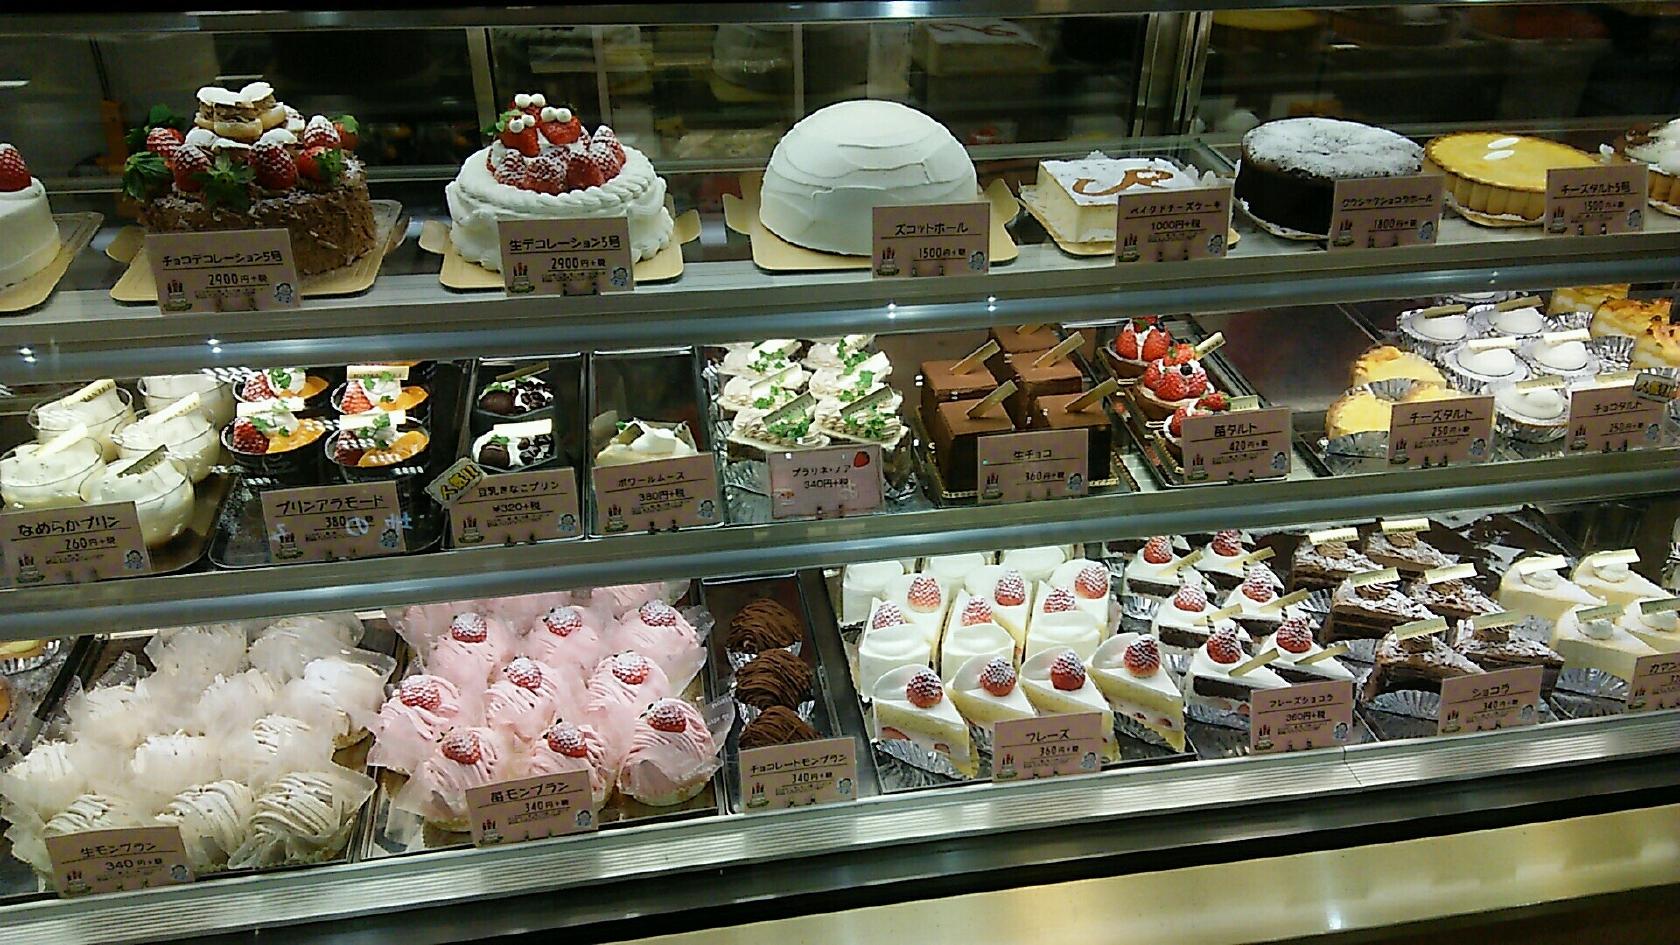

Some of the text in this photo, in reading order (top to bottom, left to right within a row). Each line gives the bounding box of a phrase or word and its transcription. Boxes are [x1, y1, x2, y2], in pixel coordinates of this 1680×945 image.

[1410, 409, 1473, 422] チーズタルト
[1014, 449, 1052, 461] 生チョコ
[275, 494, 383, 515] プリンアラモード
[18, 517, 120, 536] なめらかプリン
[1472, 683, 1510, 698] ショコラ
[1026, 729, 1070, 740] フレーズ
